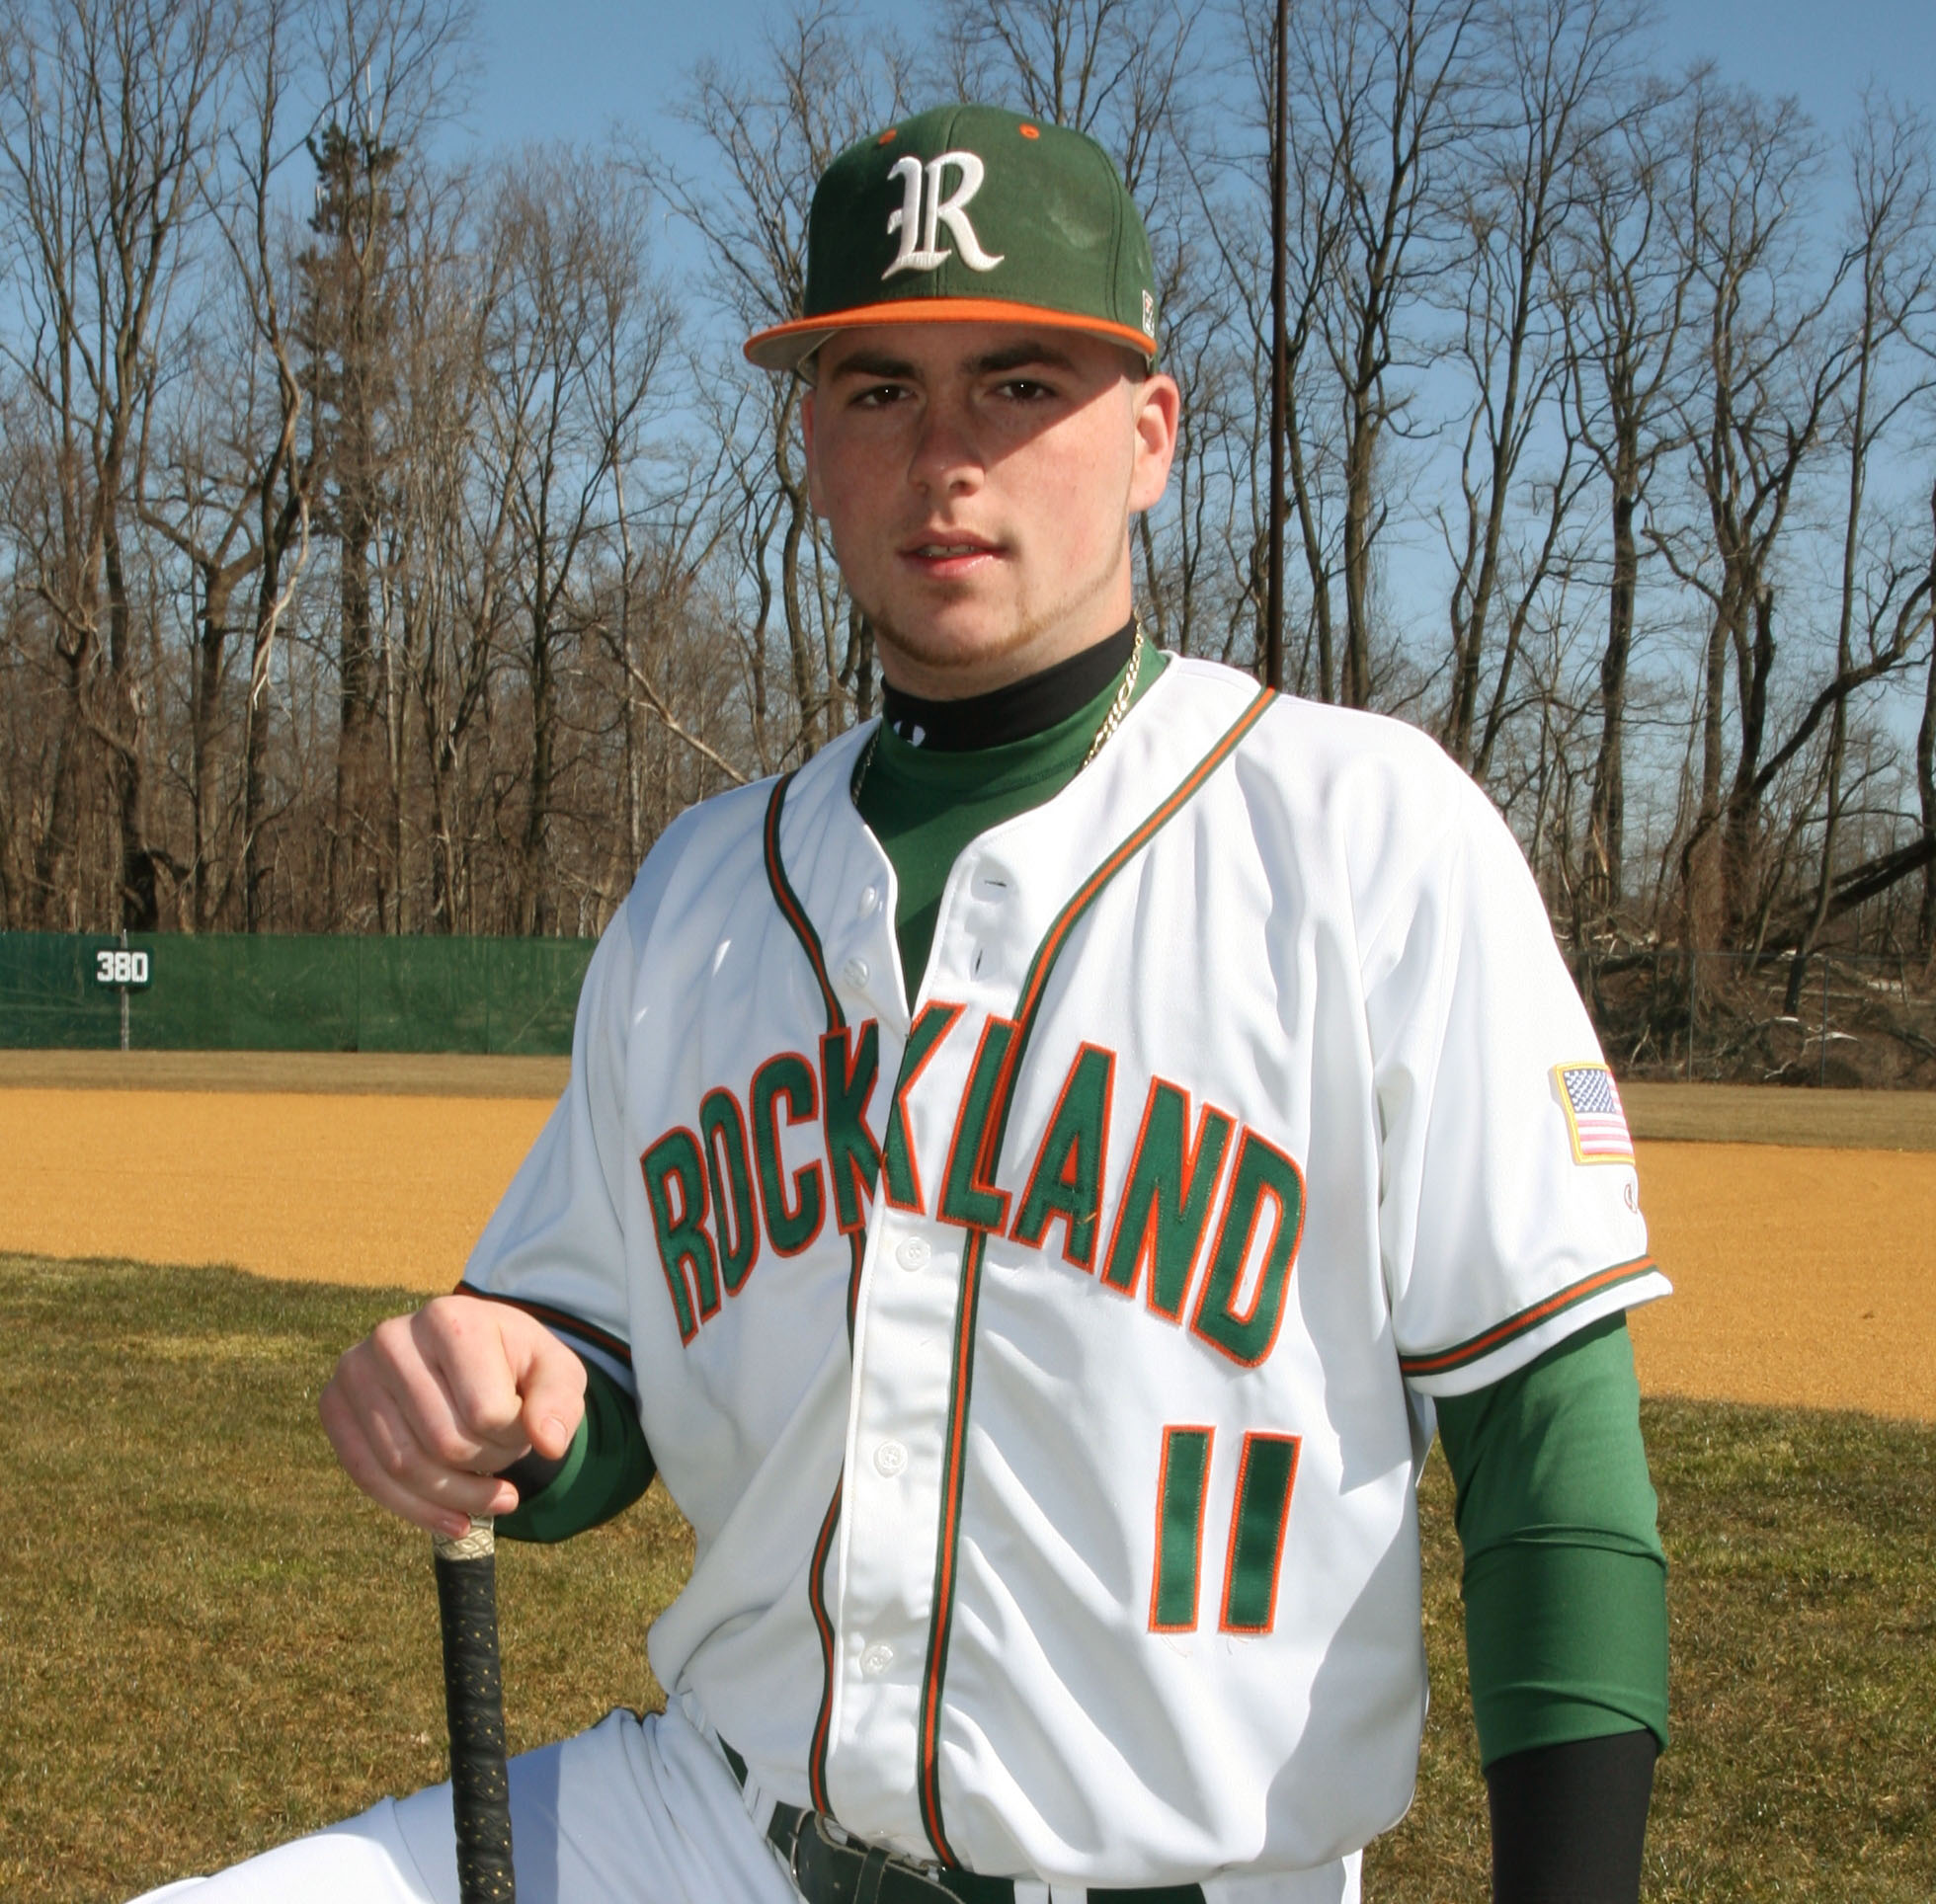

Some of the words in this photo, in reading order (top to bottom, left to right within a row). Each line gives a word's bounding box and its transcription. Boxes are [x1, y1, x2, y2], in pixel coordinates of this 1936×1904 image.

[881, 151, 1005, 280] R
[97, 951, 148, 983] 380
[640, 999, 1308, 1370] ROCKLAND
[1148, 1424, 1302, 1633] 11
